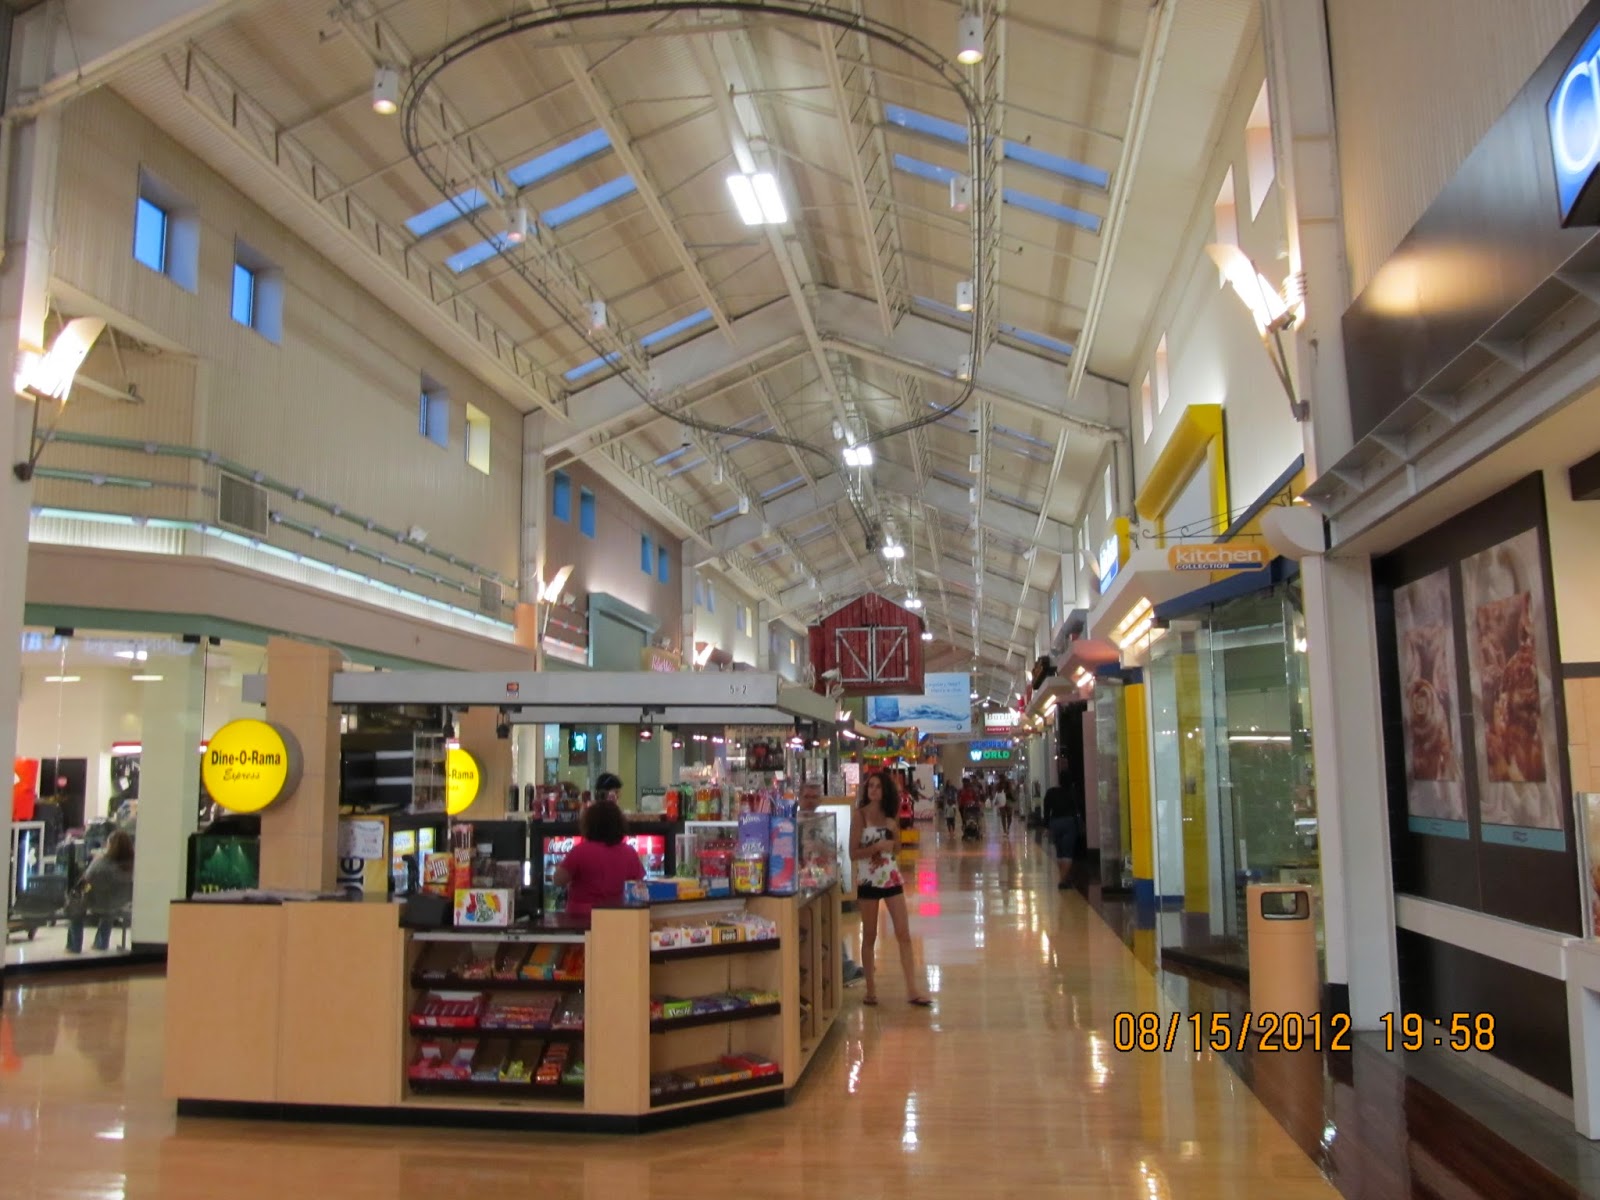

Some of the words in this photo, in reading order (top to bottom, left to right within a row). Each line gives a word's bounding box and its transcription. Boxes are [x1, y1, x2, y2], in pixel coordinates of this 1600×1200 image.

[1176, 547, 1262, 563] kitchen
[211, 750, 281, 766] Dine-O-Rama
[970, 749, 1010, 760] WORLD
